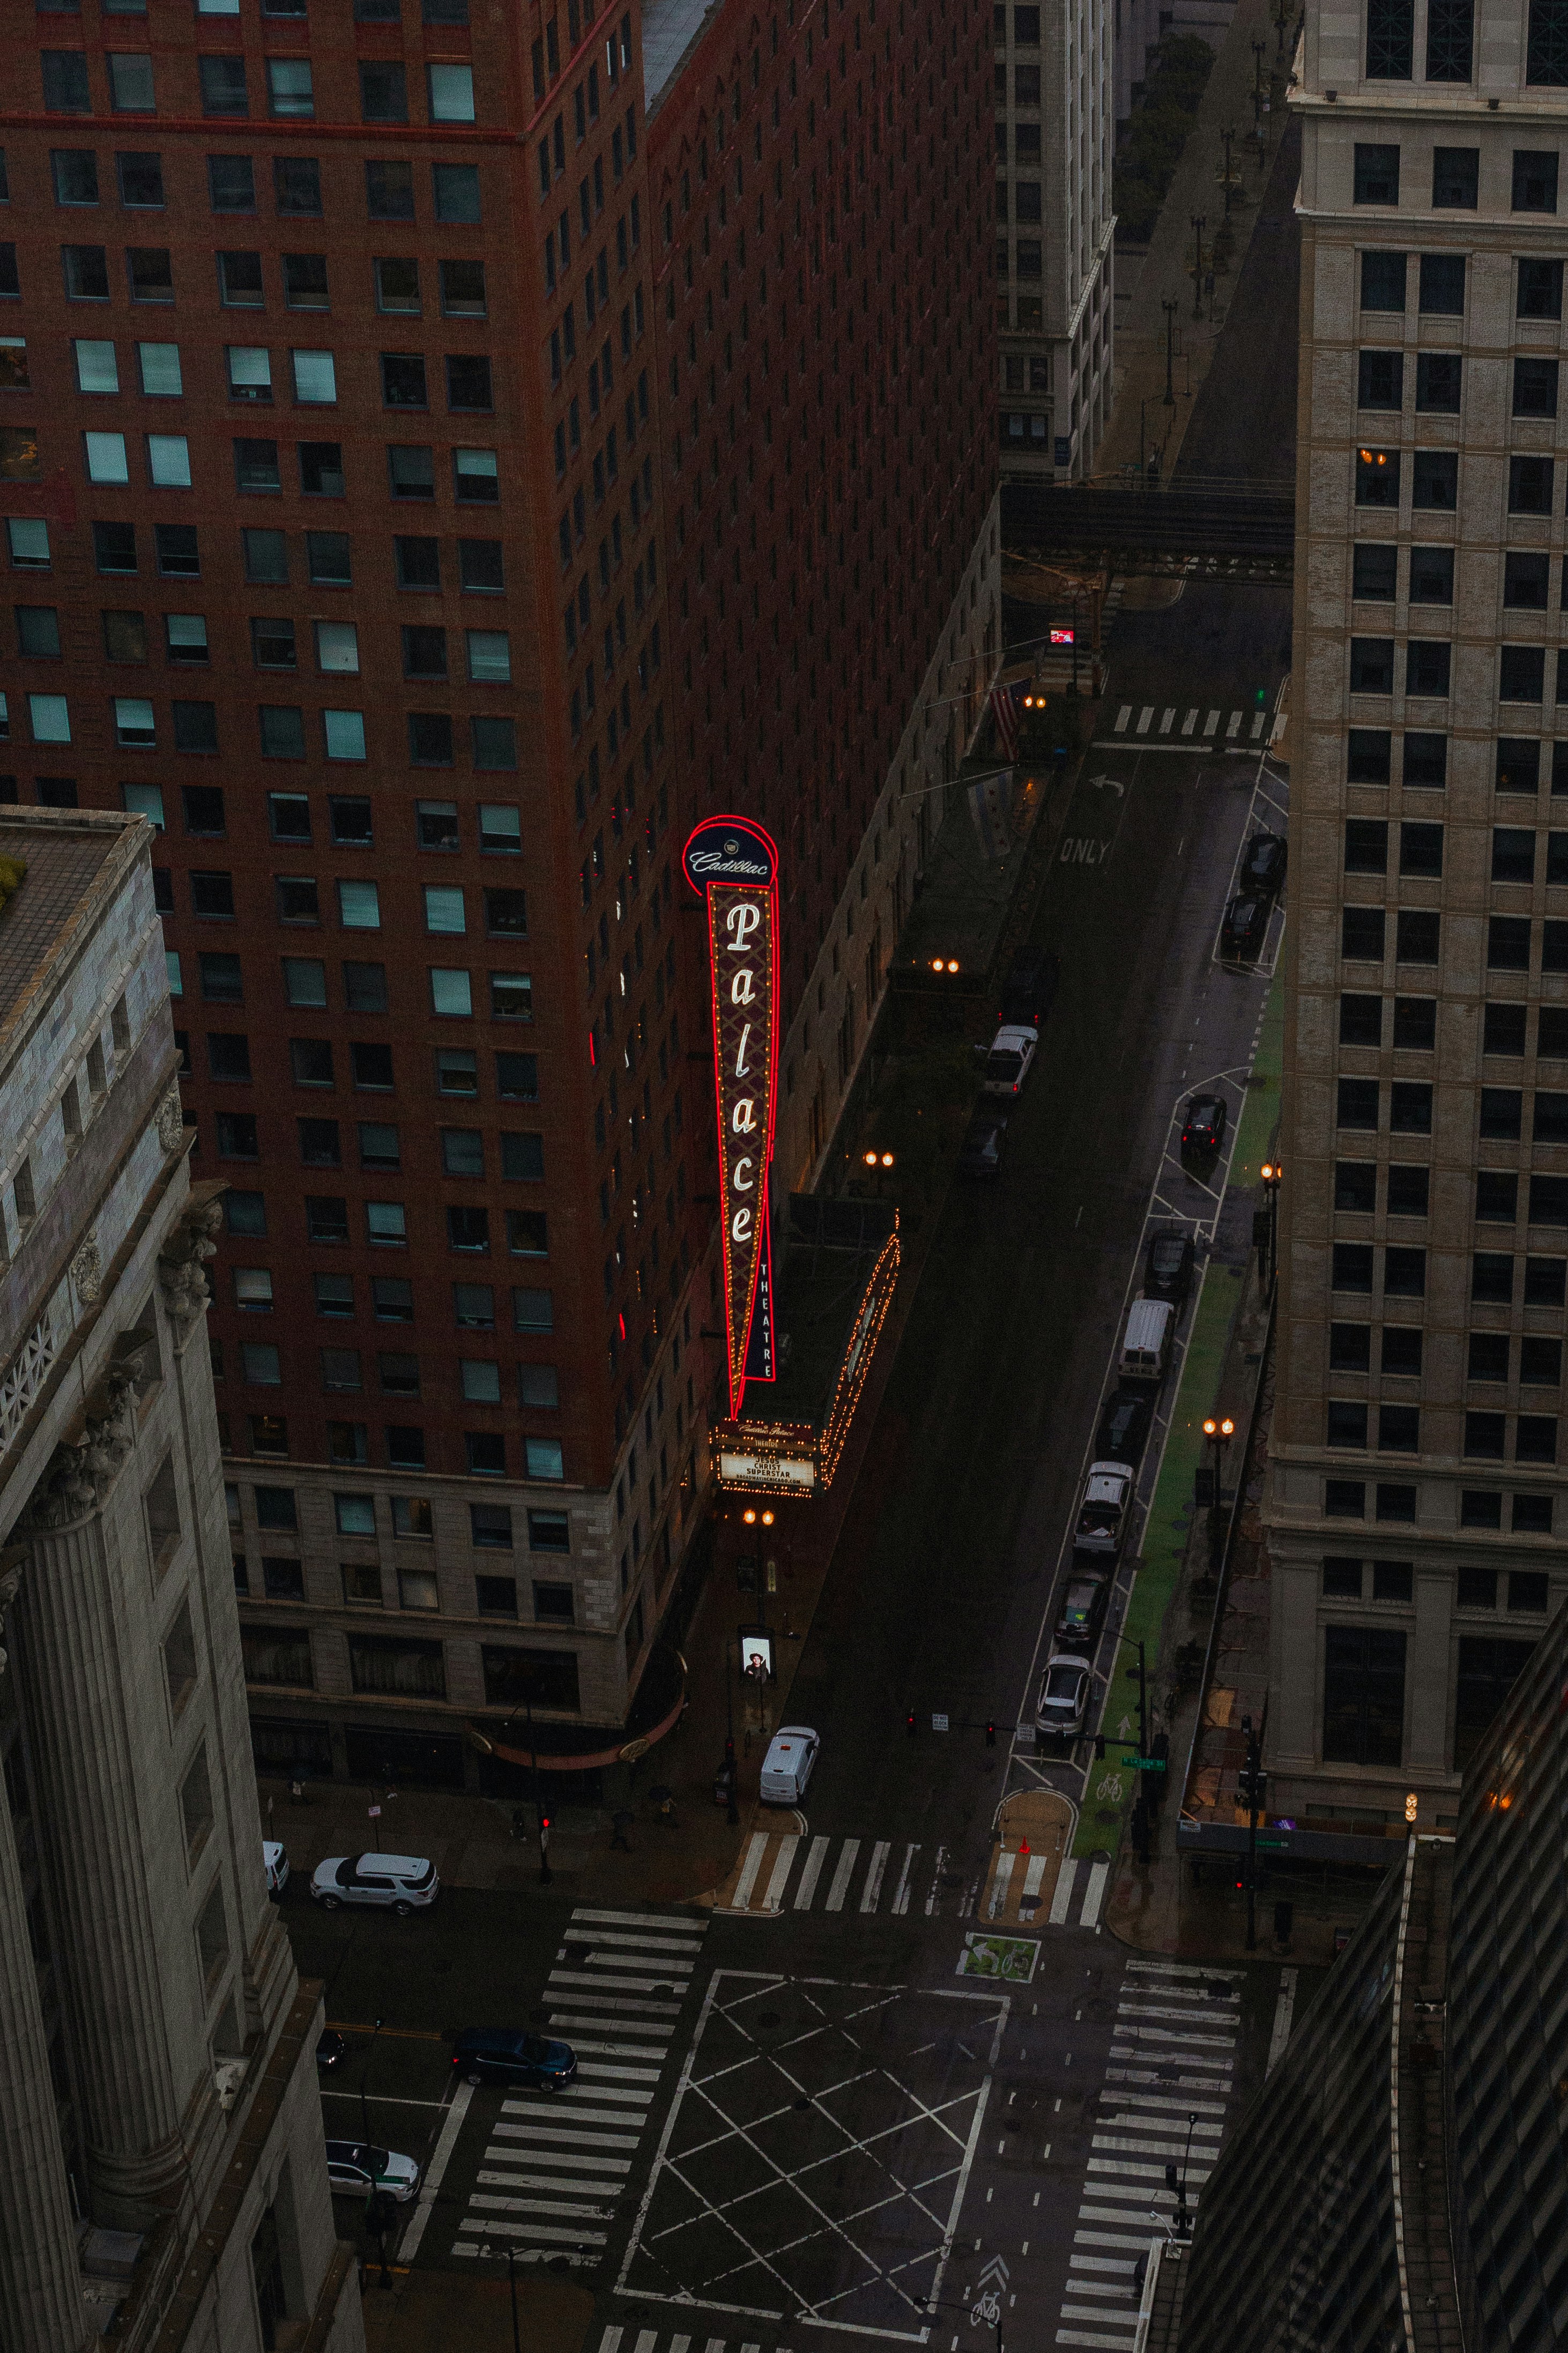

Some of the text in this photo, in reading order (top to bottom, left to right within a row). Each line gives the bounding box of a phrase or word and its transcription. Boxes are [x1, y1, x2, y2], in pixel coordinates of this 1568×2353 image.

[1060, 838, 1112, 864] ONLY
[689, 852, 768, 875] Cadillac
[726, 904, 760, 1241] Palace
[760, 1263, 771, 1377] THEATRE
[738, 1424, 794, 1436] Cadillac Palace
[755, 1439, 778, 1447] THEATRE
[746, 1468, 790, 1478] SUPERSTAR
[754, 1463, 781, 1471] CHRIST
[736, 1474, 801, 1484] BROADWAYINCHICAGO.COM
